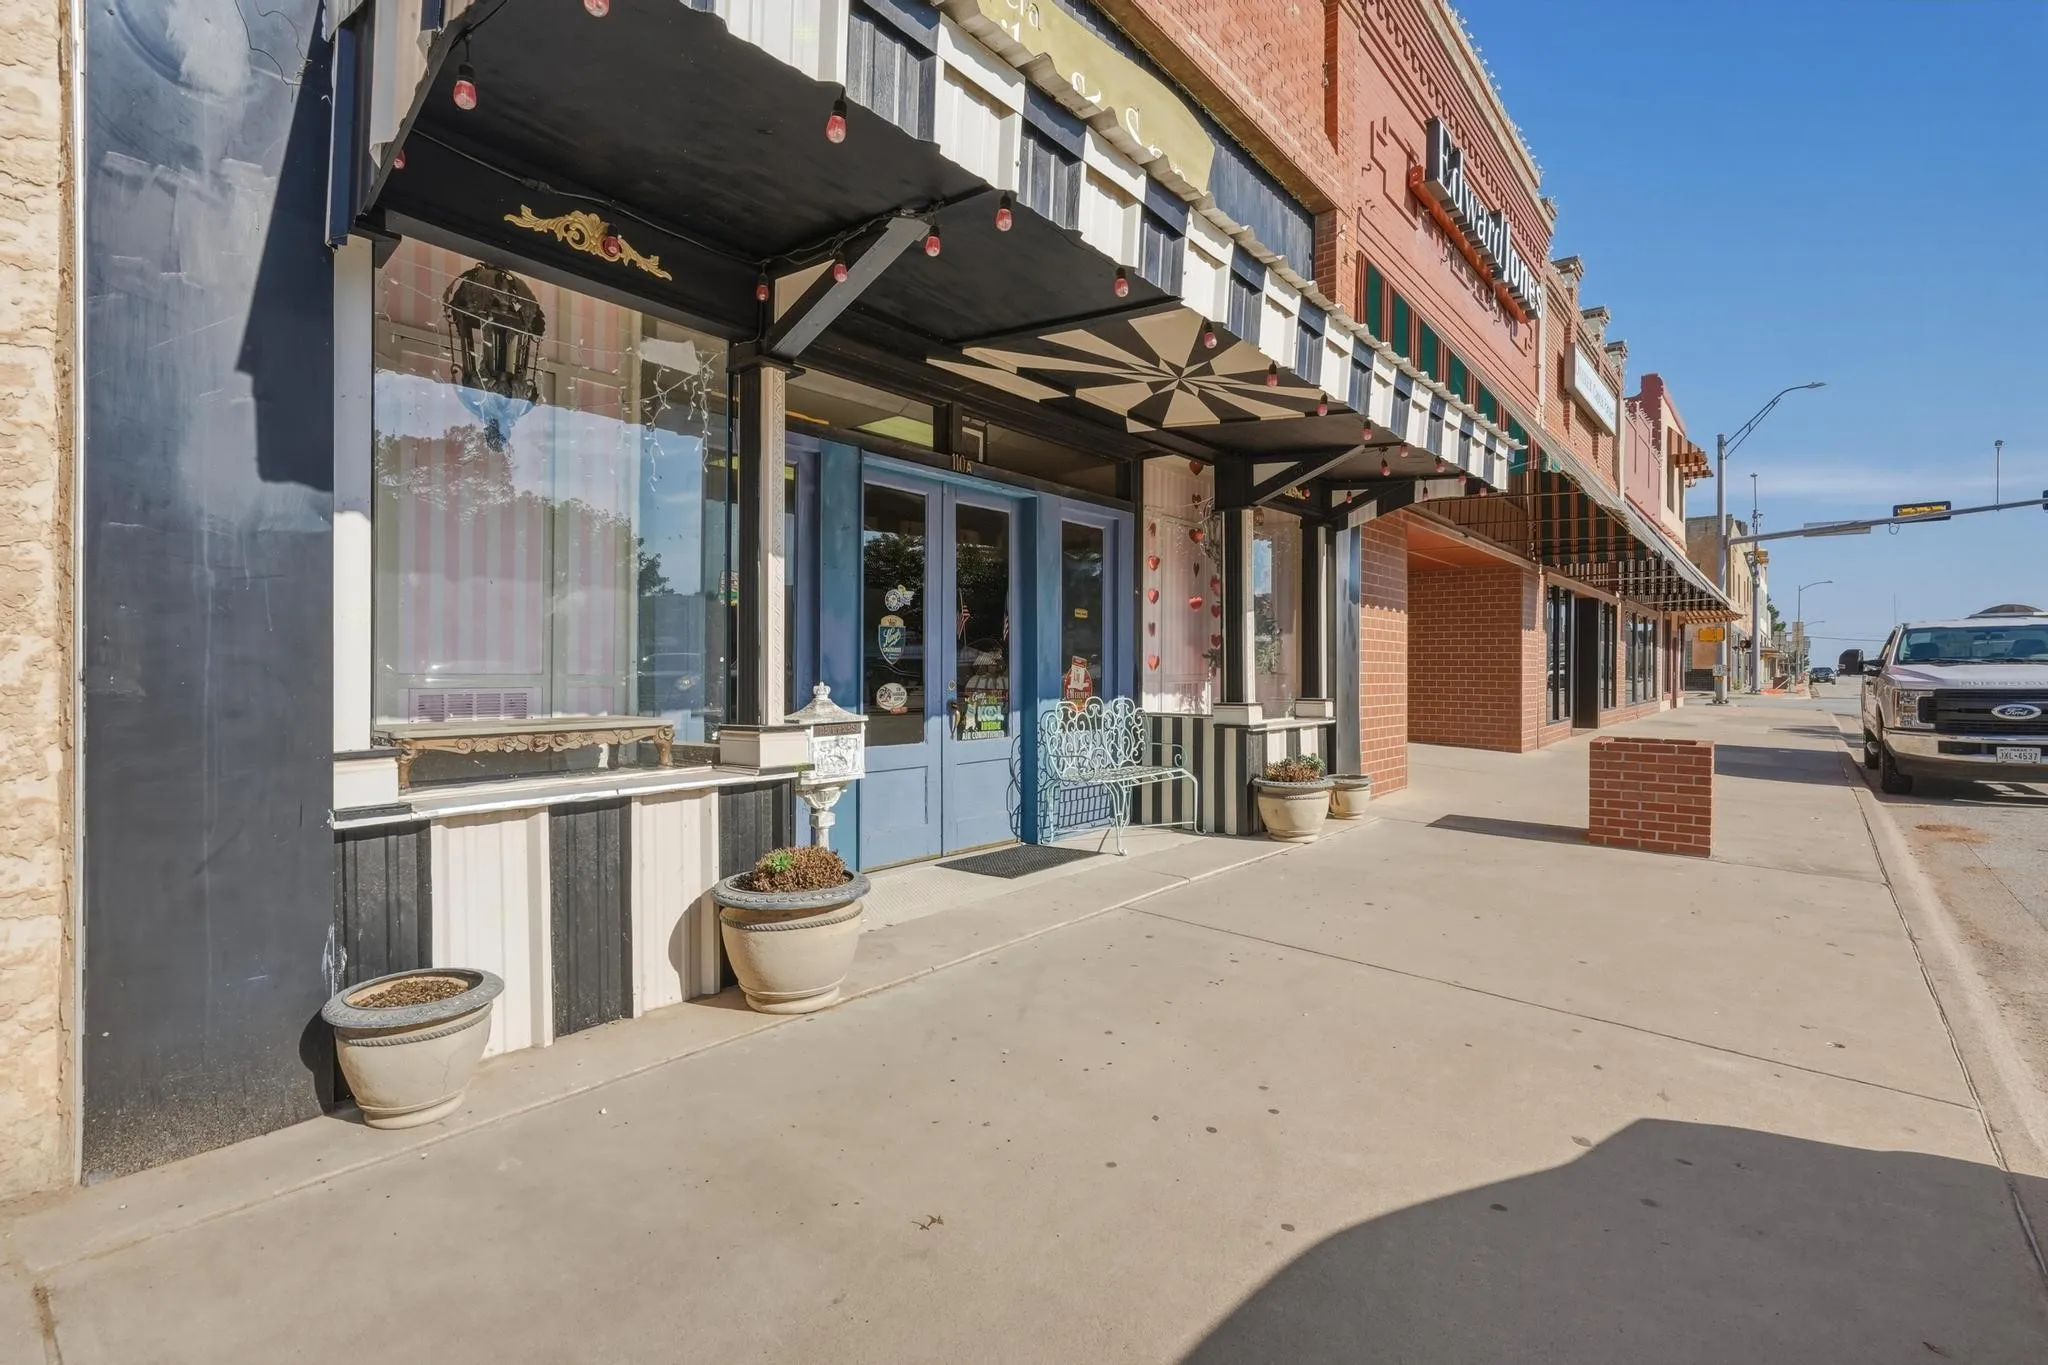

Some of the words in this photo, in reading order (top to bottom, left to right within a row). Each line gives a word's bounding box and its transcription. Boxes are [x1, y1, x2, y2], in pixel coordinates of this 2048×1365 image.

[1438, 123, 1505, 268] Edward
[1503, 222, 1543, 320] Jones
[2004, 707, 2030, 717] Ford
